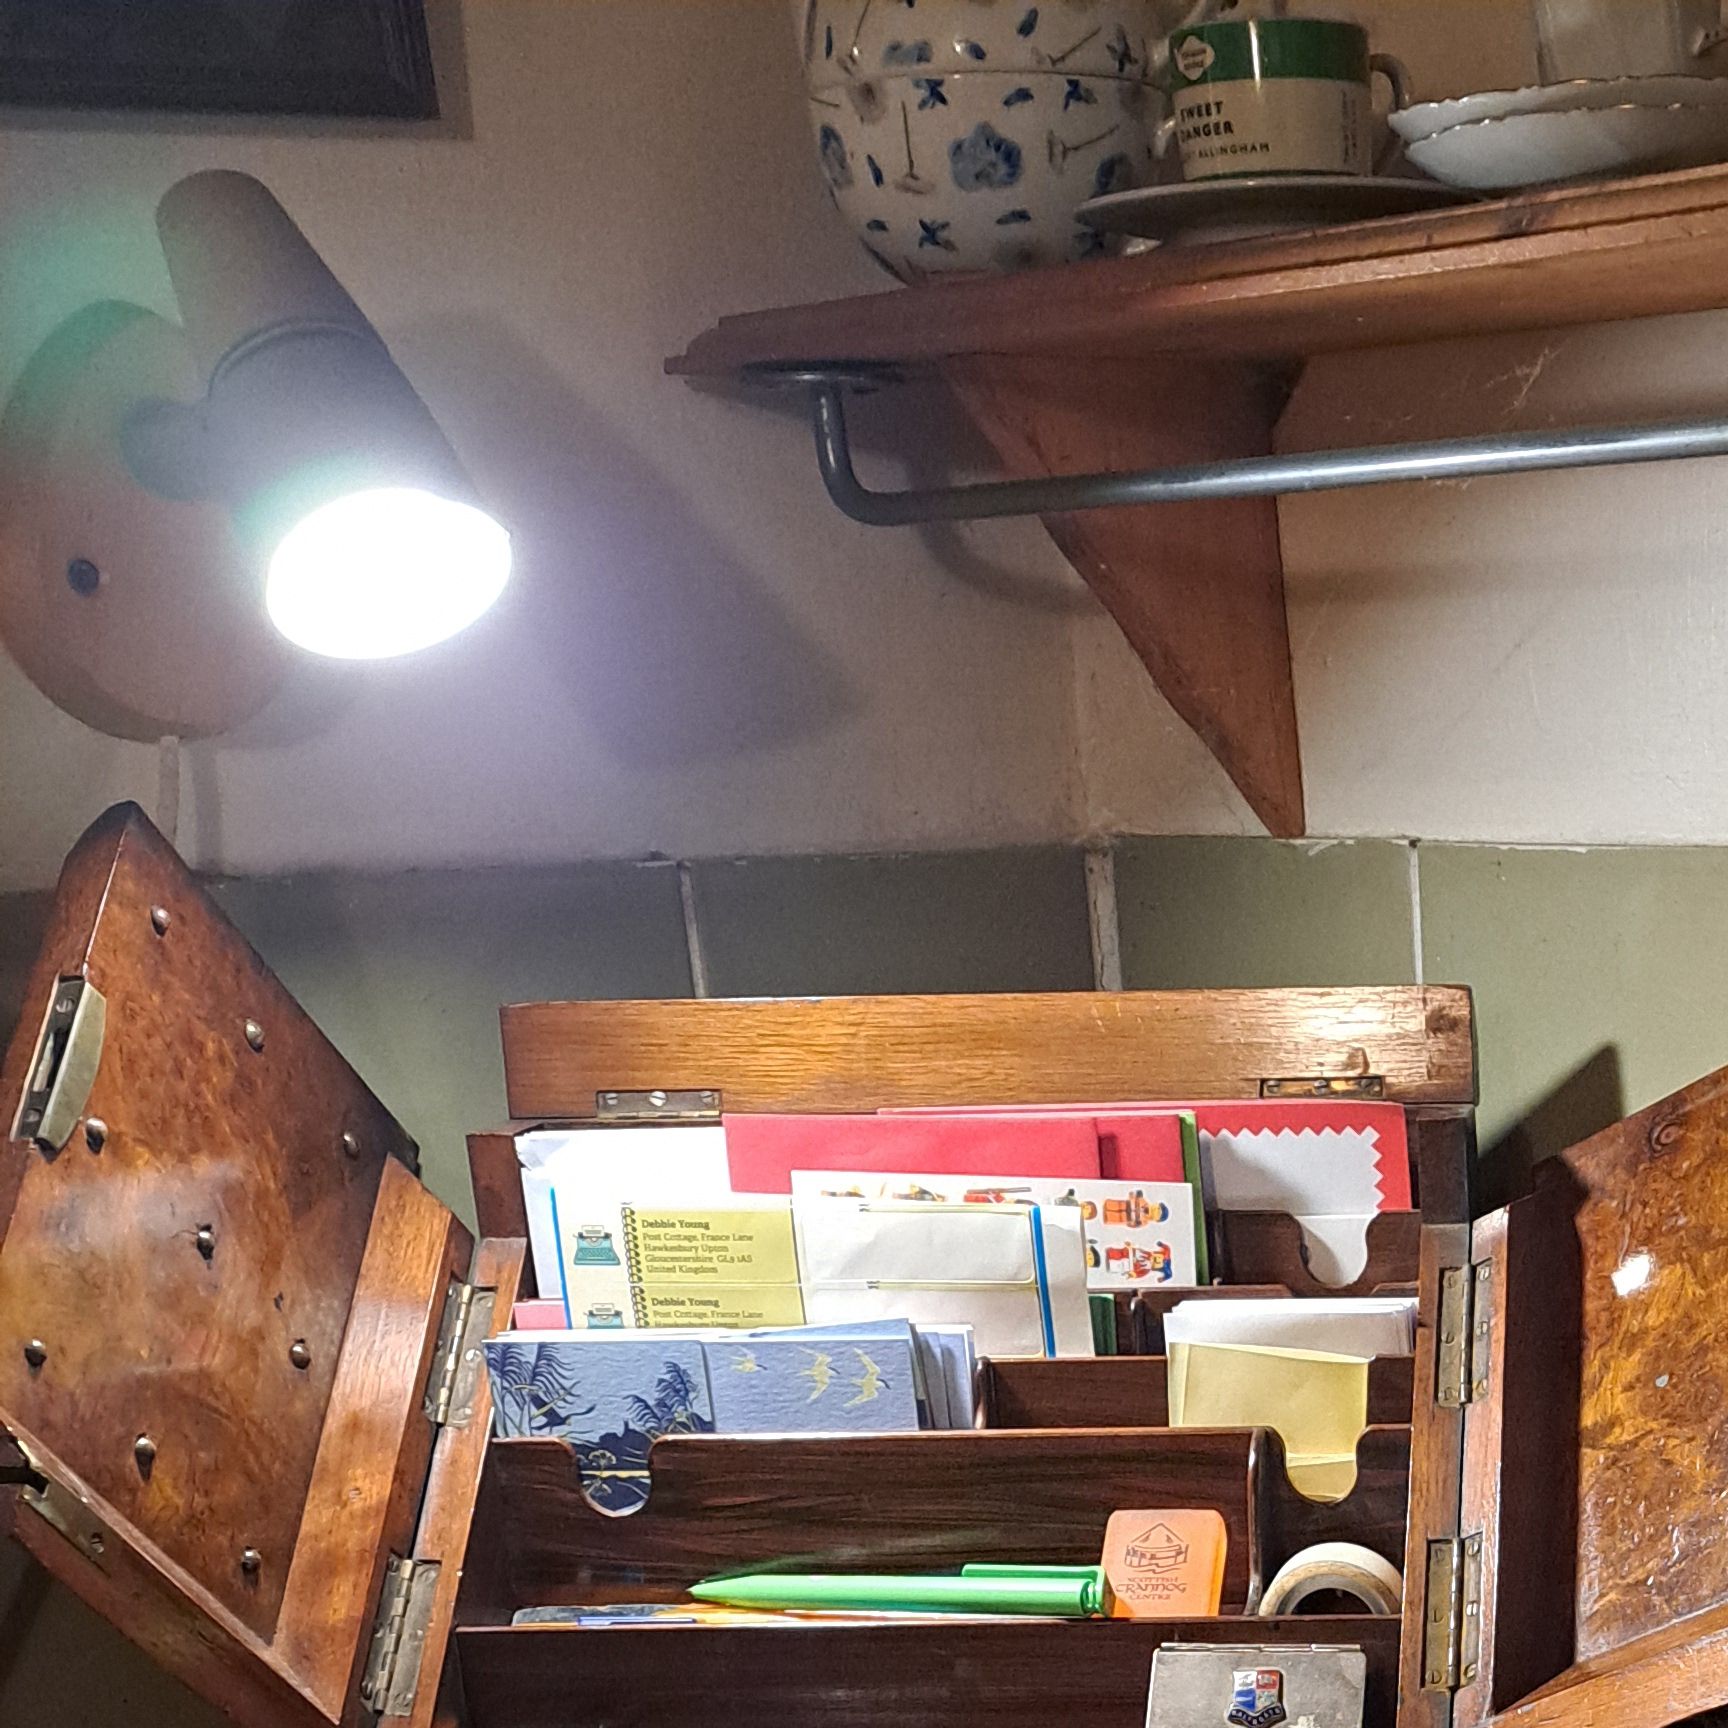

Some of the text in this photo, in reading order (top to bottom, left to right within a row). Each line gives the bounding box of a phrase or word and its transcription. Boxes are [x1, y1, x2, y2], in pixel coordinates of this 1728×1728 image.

[641, 1219, 710, 1230] Debbie Young
[643, 1233, 661, 1241] Post
[701, 1233, 730, 1241] France
[732, 1233, 754, 1242] Lane
[701, 1244, 729, 1255] Upton
[646, 1265, 718, 1275] United Kingdom
[650, 1297, 720, 1308] Debbie Young
[653, 1310, 671, 1318] Post
[710, 1310, 740, 1318] France
[742, 1310, 764, 1319] Lane
[1115, 1582, 1188, 1594] CRANNOG
[1129, 1593, 1171, 1601] CENTRE
